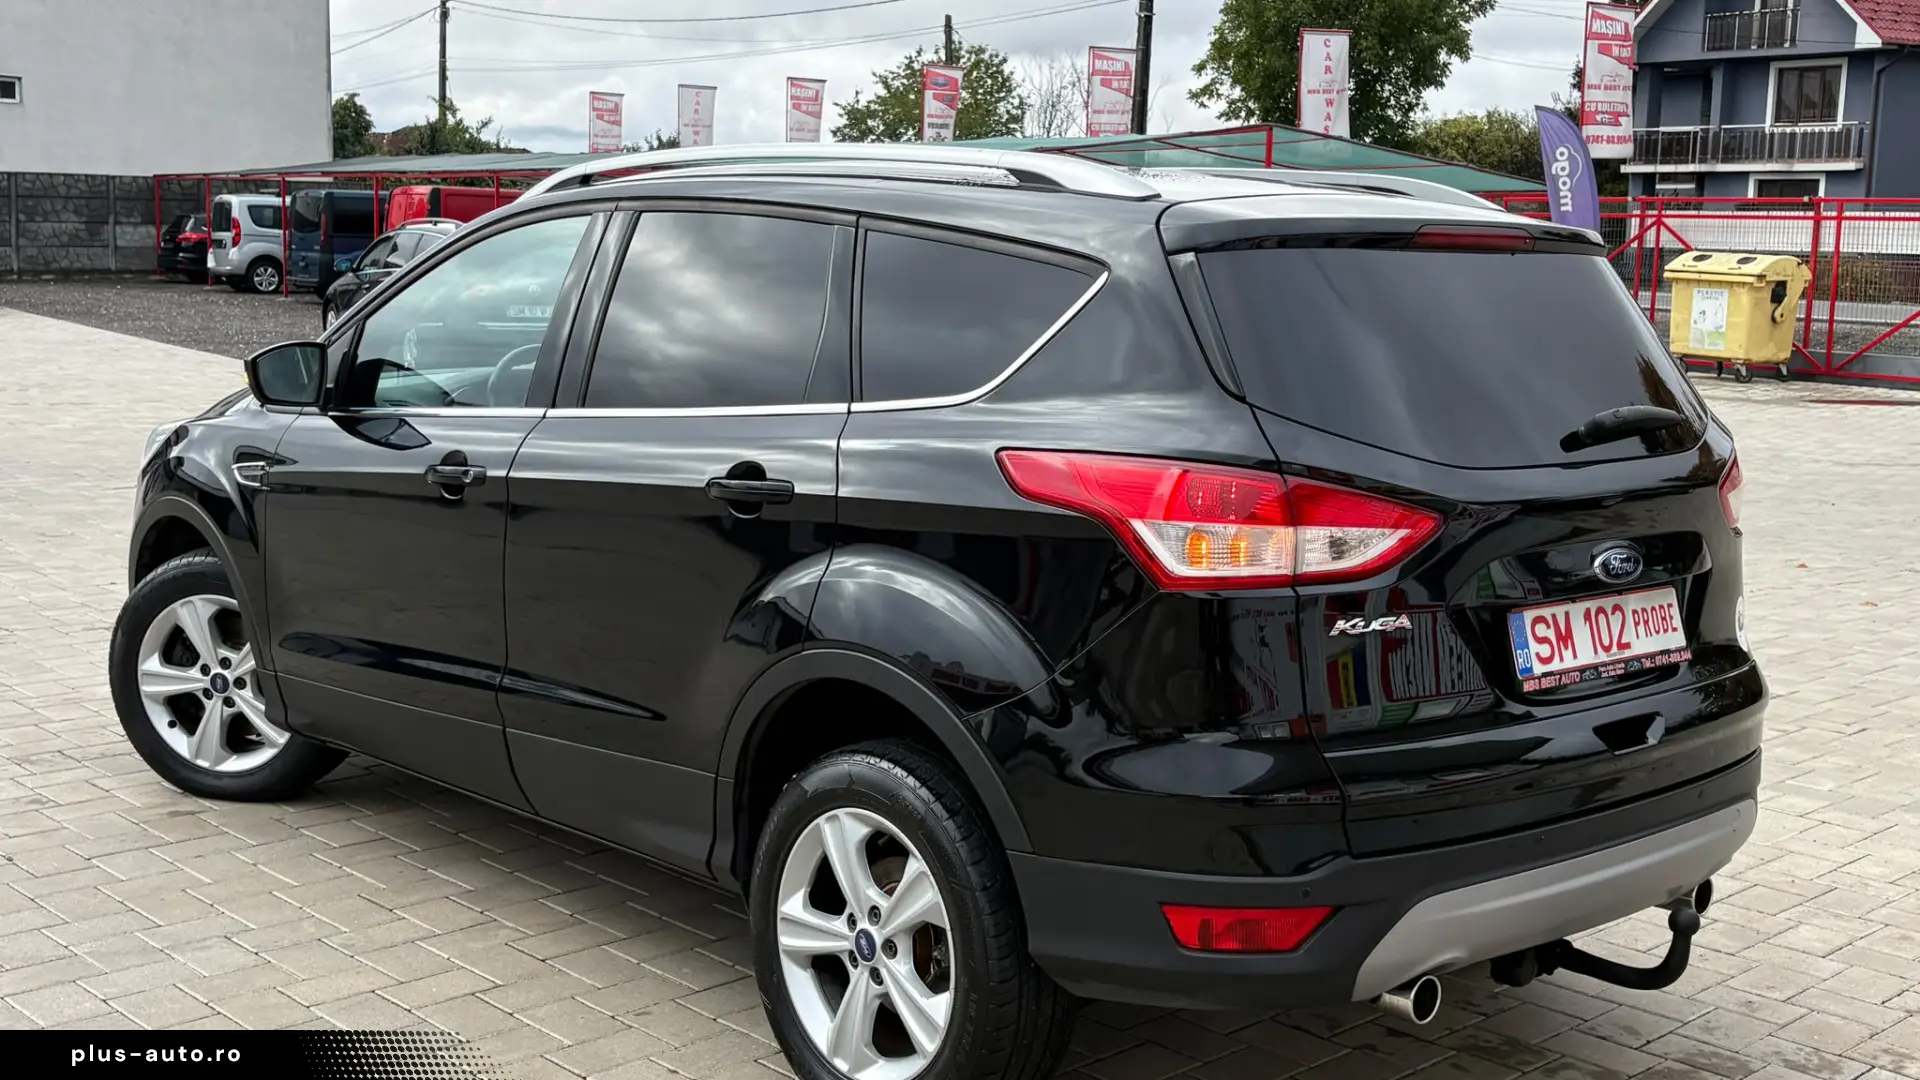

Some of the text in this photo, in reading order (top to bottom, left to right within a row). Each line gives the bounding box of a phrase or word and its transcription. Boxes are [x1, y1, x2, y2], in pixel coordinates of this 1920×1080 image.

[1323, 38, 1333, 75] CAR
[1610, 554, 1636, 574] Ford
[1328, 613, 1413, 637] KUGA
[1530, 603, 1678, 666] SM 102 PROBE
[1517, 649, 1532, 669] RO
[1523, 671, 1580, 692] MBS BEST AUTO
